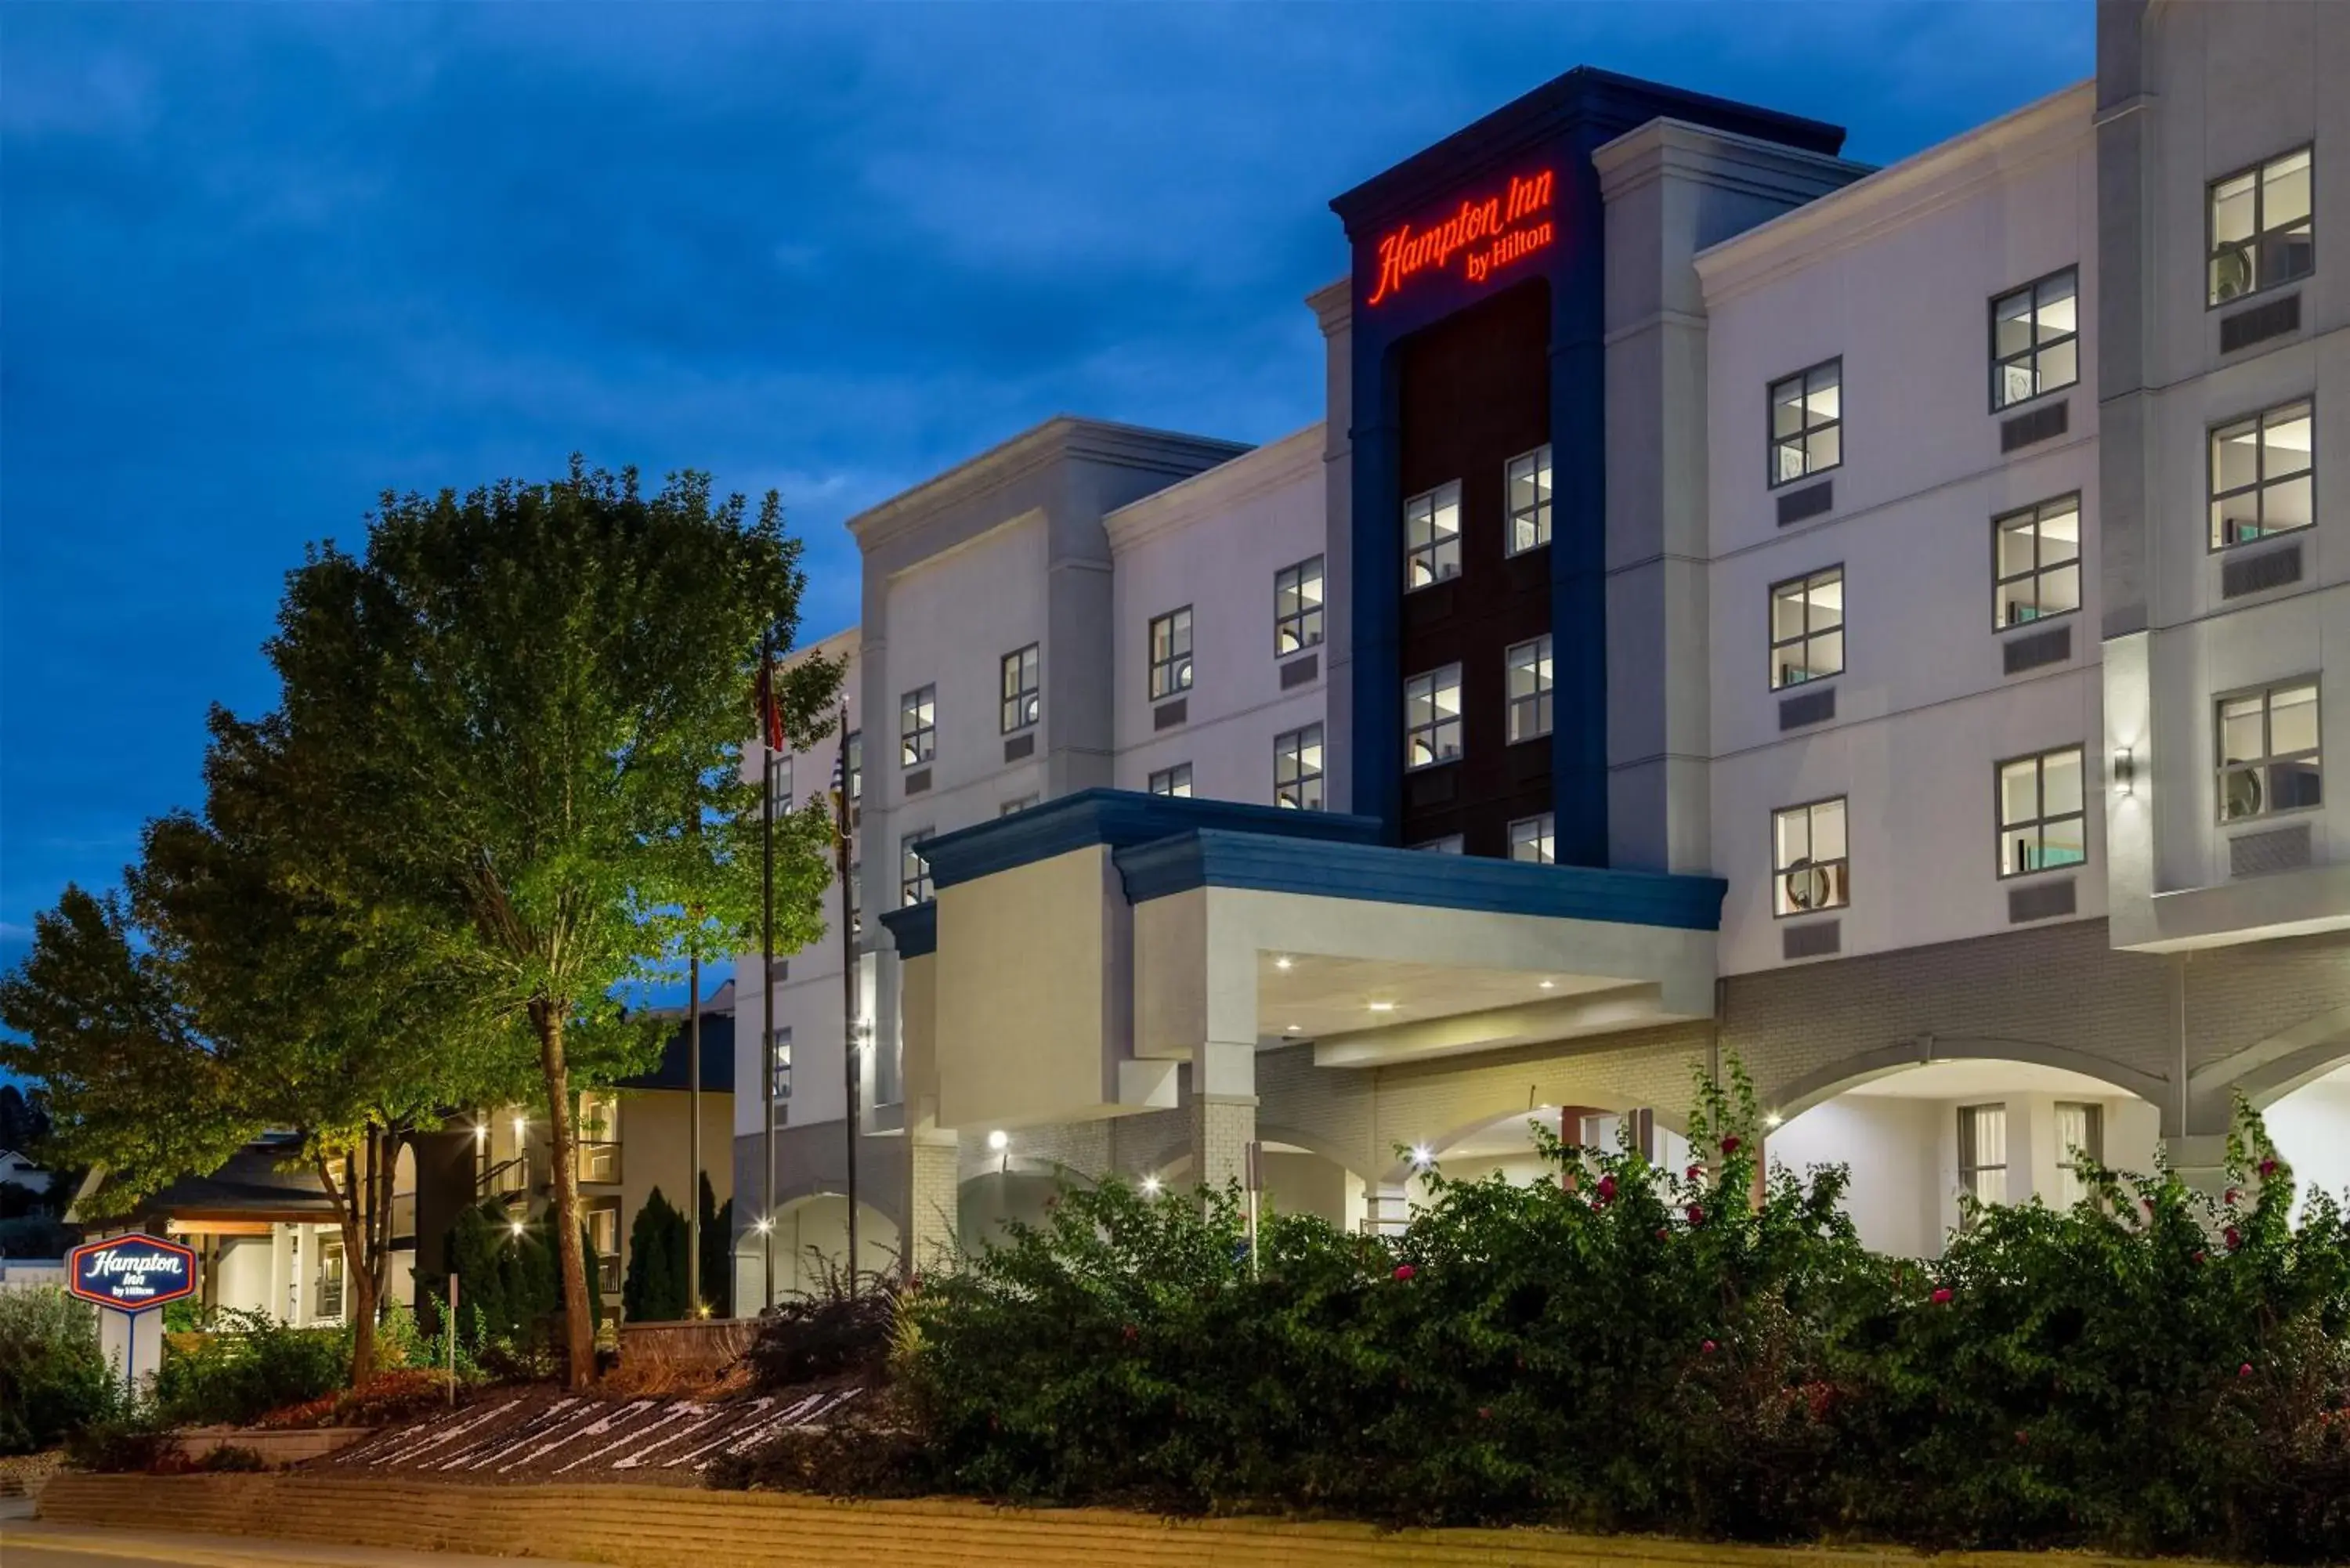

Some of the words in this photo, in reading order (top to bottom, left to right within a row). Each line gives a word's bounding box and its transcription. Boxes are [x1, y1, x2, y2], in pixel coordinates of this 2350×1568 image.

[1368, 199, 1504, 305] Hampton
[1506, 170, 1552, 222] Inn
[1467, 252, 1490, 280] by
[1492, 222, 1552, 267] Hilton
[85, 1249, 183, 1278] Hampton
[111, 1285, 125, 1297] by
[122, 1272, 146, 1285] Inn
